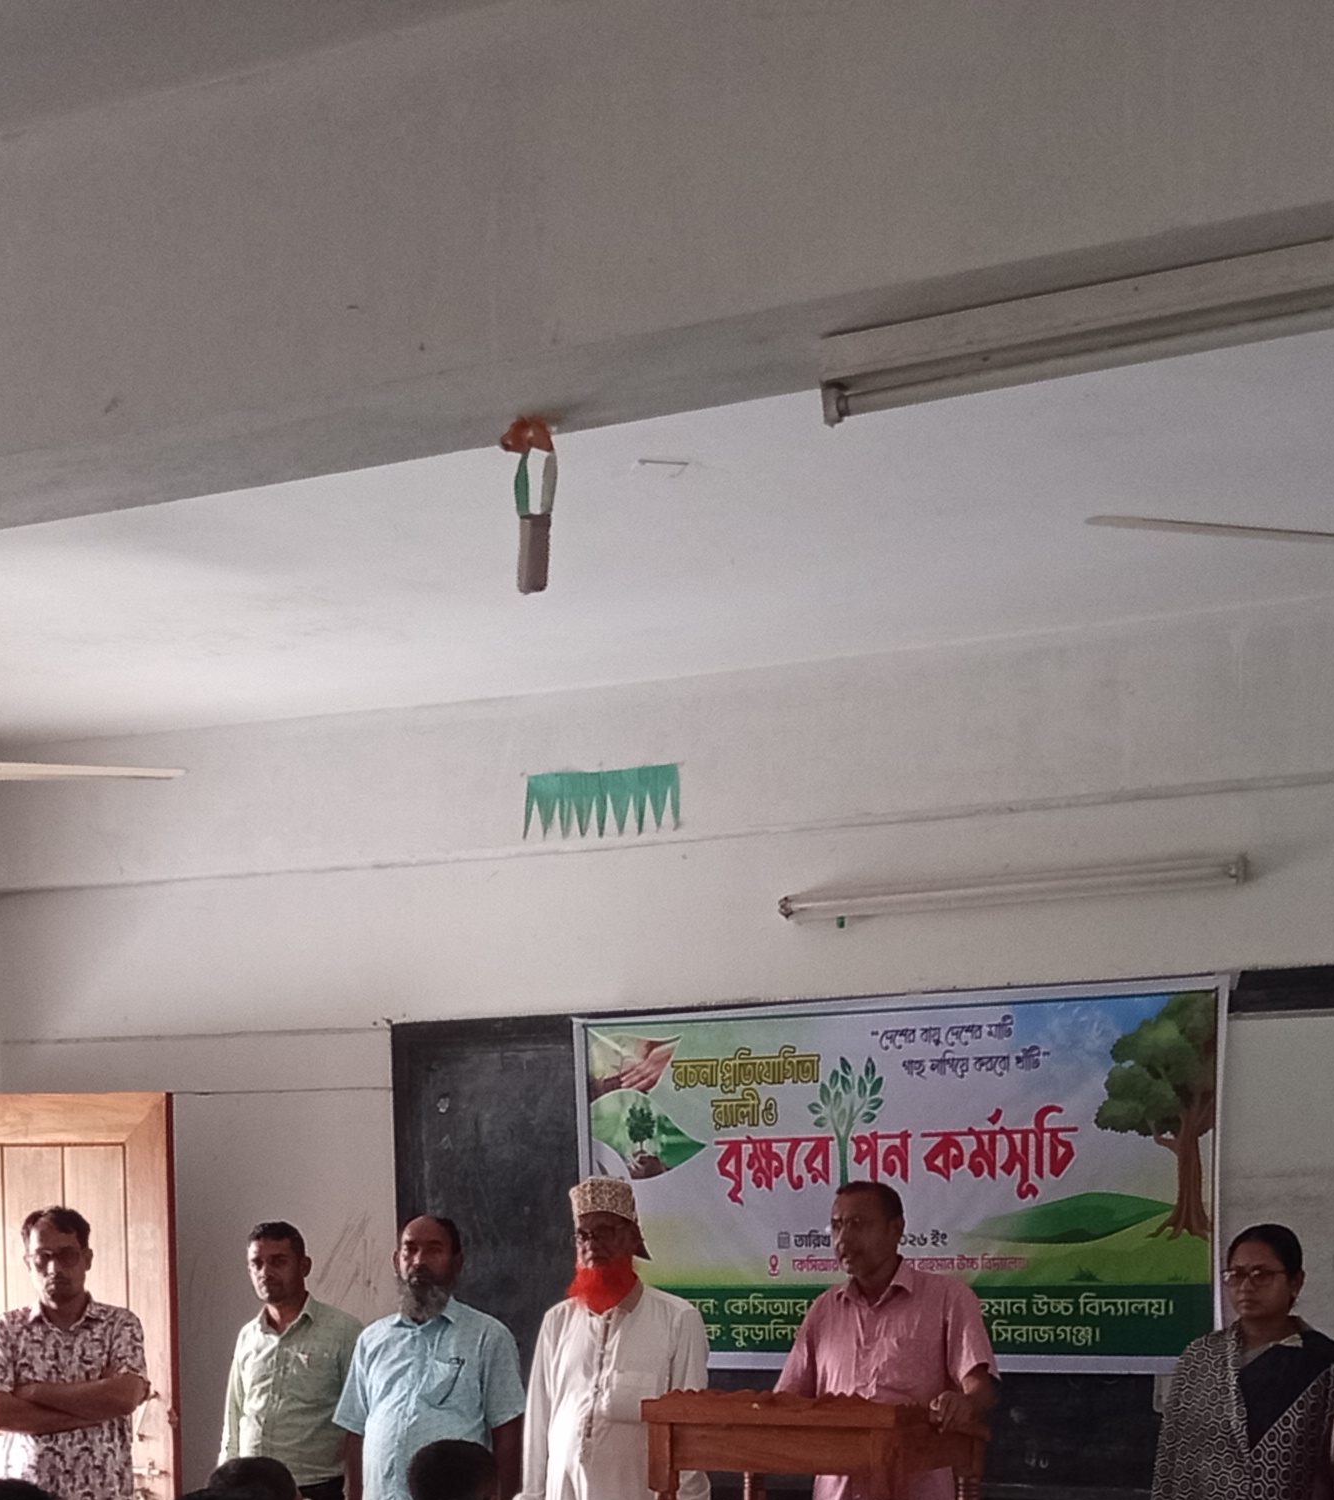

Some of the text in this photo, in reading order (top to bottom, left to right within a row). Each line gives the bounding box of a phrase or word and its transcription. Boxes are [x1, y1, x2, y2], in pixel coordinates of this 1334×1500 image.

[945, 1023, 983, 1046] দেশের
[987, 1014, 1014, 1041] মাটি
[671, 1044, 821, 1094] রচনা প্রতিযোগিতা
[902, 1058, 927, 1079] গাছ
[929, 1049, 970, 1079] লাগিয়ে
[973, 1054, 1010, 1077] করবো
[762, 1097, 779, 1126] ও
[920, 1103, 1079, 1200] কর্মসূচি
[793, 1228, 831, 1249] তারিখ
[898, 1233, 928, 1247] ০২৬
[724, 1291, 808, 1317] কেসিআর
[980, 1297, 1028, 1318] হমান
[1031, 1293, 1076, 1317] উচ্চ
